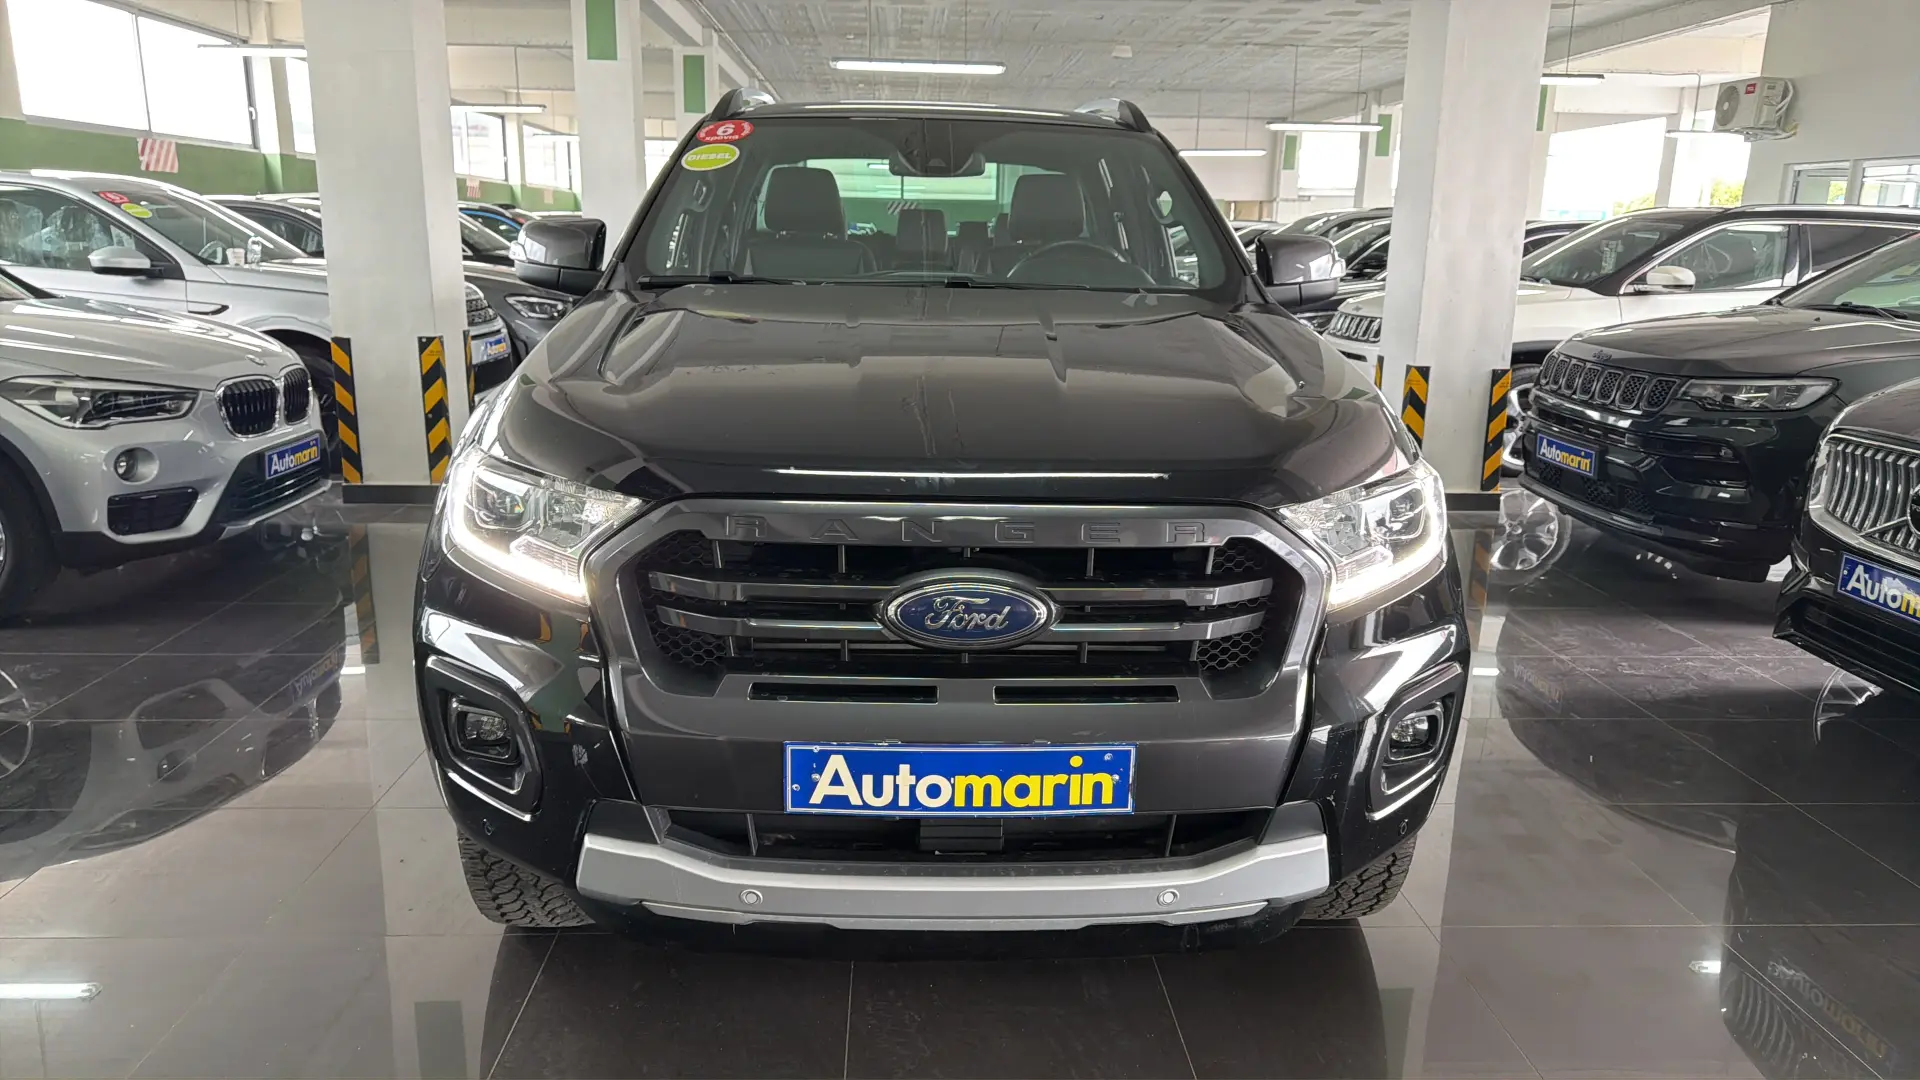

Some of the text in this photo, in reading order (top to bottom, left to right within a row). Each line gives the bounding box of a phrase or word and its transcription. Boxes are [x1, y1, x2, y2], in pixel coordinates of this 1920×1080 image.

[716, 122, 735, 136] 6
[687, 152, 732, 161] DIESEL
[271, 441, 318, 475] Automarin
[1540, 438, 1591, 472] Automarin
[726, 515, 1205, 543] RANGER
[924, 595, 1012, 631] Ford
[809, 753, 1114, 807] Automarin
